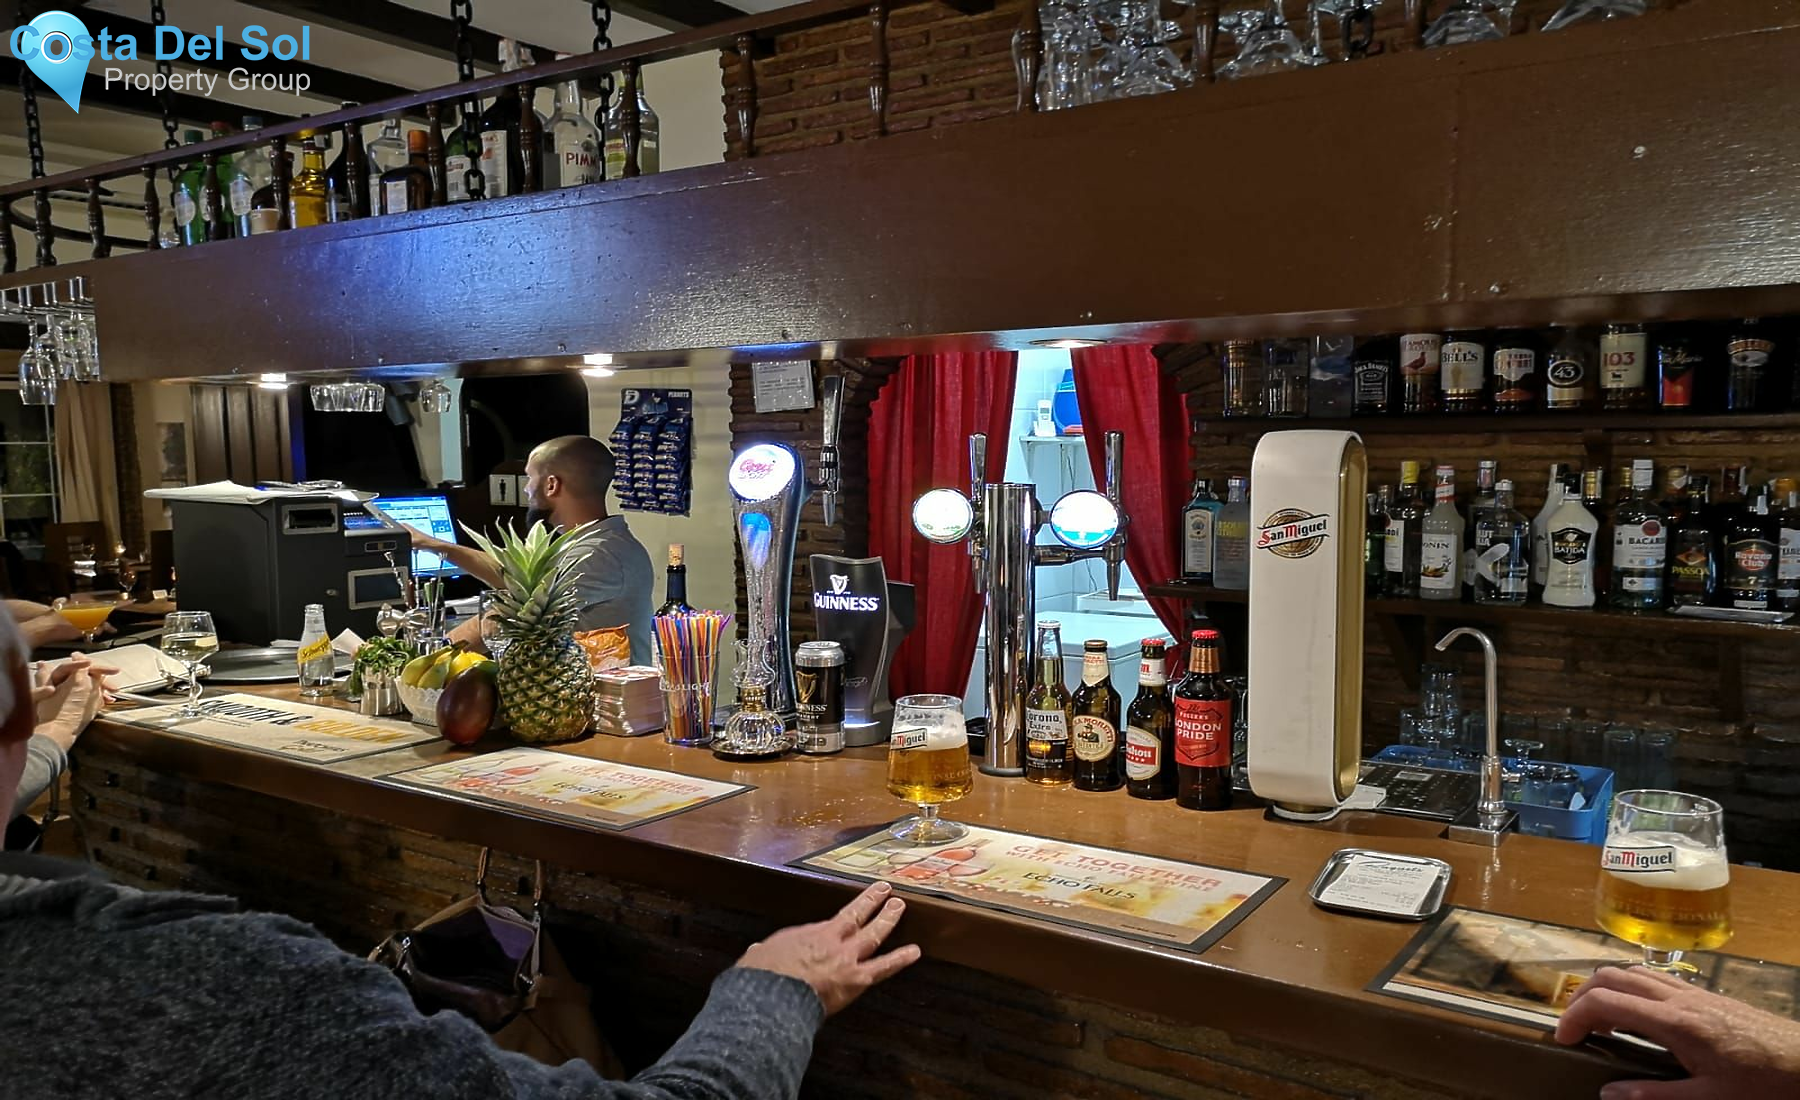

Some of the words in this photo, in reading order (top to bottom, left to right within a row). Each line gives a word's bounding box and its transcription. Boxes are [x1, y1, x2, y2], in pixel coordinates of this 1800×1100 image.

[566, 152, 598, 166] PIMM
[1603, 351, 1635, 367] 103
[1554, 366, 1575, 379] 43
[814, 592, 880, 611] GUINNESS
[1177, 728, 1214, 741] PRIDE
[1012, 844, 1069, 859] GET
[1074, 855, 1222, 887] TOGETHER
[1022, 871, 1082, 888] ECHO
[1081, 883, 1138, 900] FALLS
